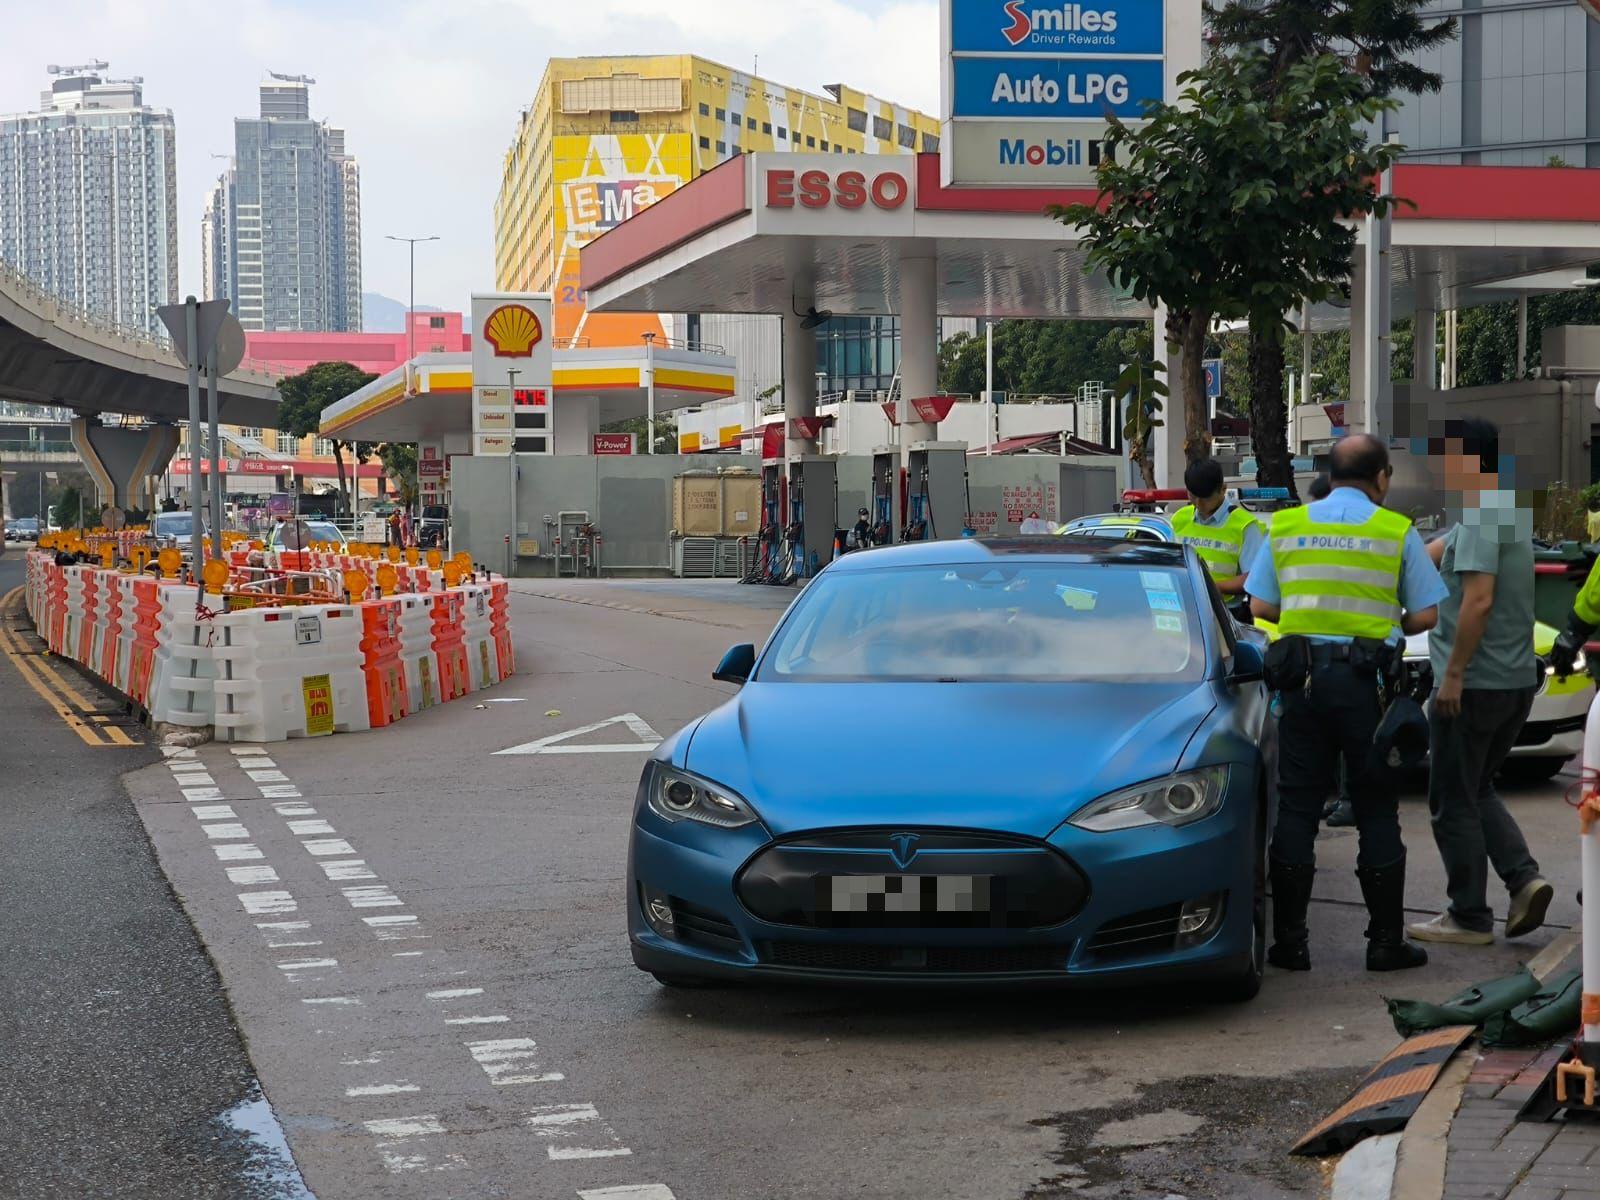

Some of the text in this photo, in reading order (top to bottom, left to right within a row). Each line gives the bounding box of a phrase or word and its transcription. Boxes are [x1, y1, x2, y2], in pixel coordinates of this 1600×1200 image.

[1001, 1, 1117, 45] Smiles
[1032, 33, 1116, 45] Driver Rewards
[991, 72, 1129, 104] Auto LPG
[999, 139, 1081, 165] Mobil
[575, 183, 662, 221] E-Ma
[766, 169, 908, 210] ESSO
[1190, 537, 1212, 547] POLICE
[1311, 536, 1354, 549] POLICE
